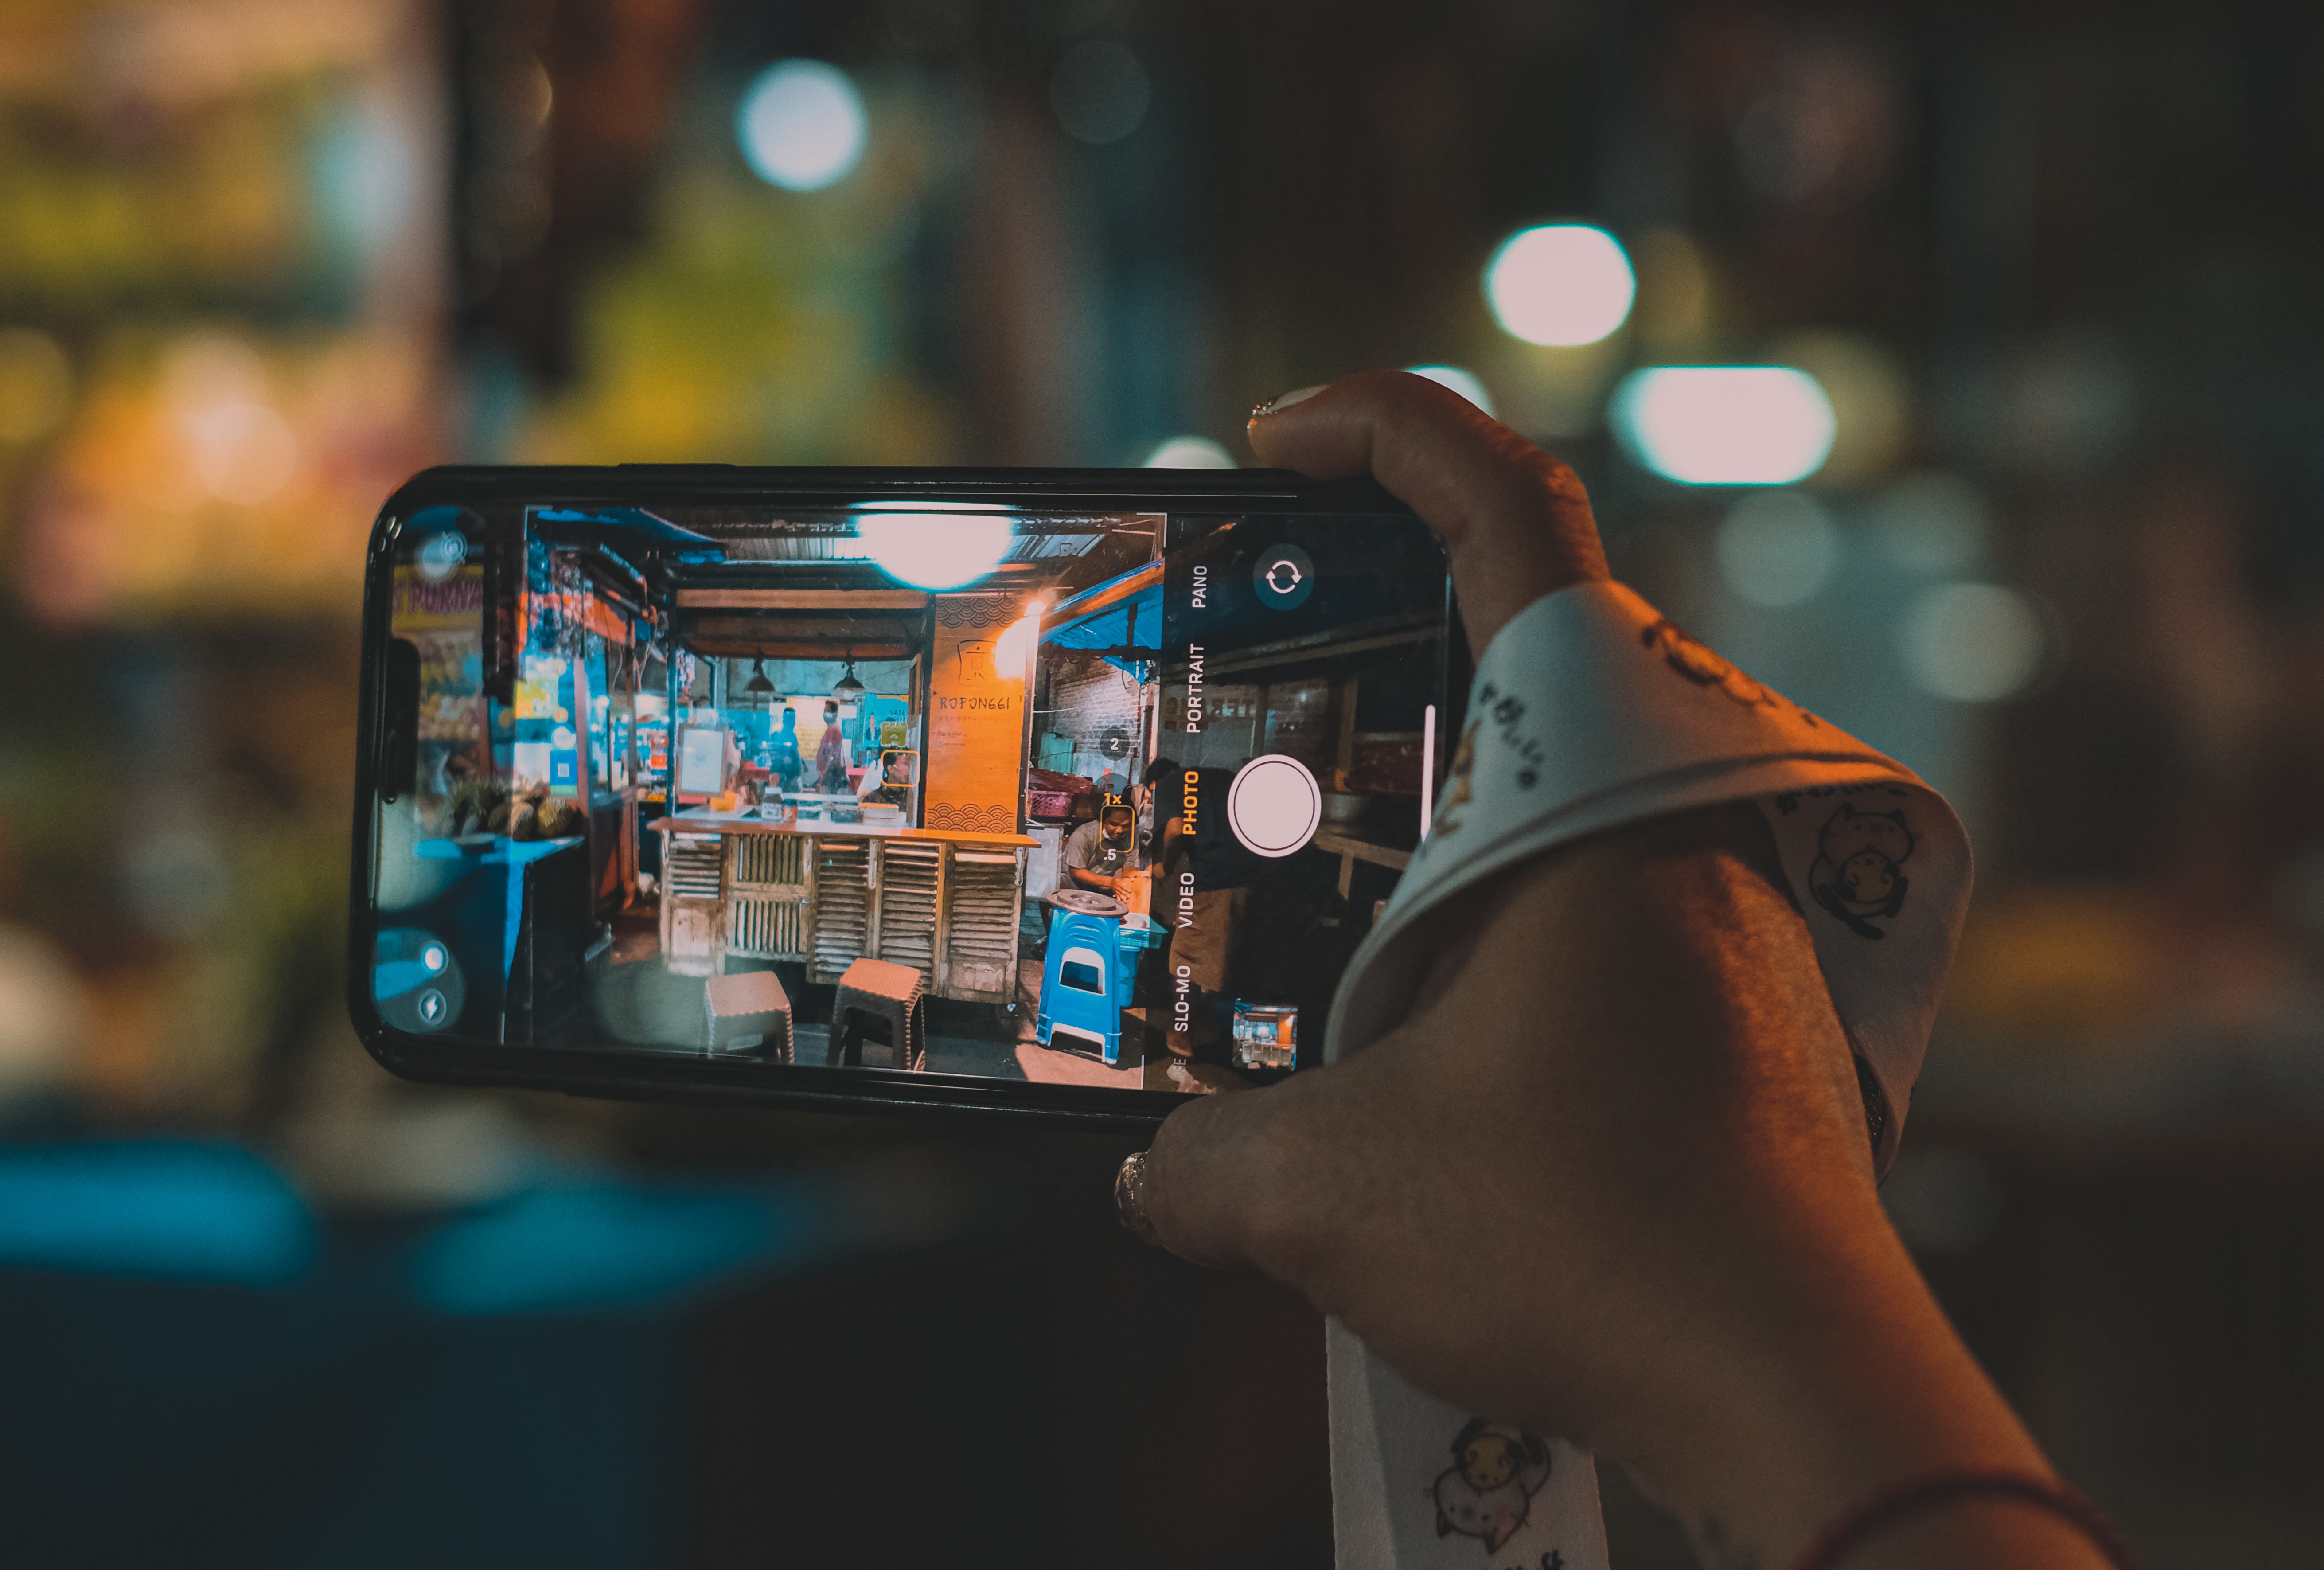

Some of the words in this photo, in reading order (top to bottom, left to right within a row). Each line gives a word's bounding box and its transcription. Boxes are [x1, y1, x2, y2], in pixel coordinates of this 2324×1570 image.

[1192, 566, 1207, 608] PANO
[1187, 643, 1204, 732] PORTRAIT
[1111, 738, 1119, 750] 2
[1183, 771, 1199, 835] PHOTO
[1104, 849, 1116, 861] .5
[1179, 873, 1195, 928] VIDEO
[1174, 965, 1191, 1032] SLO-MO
